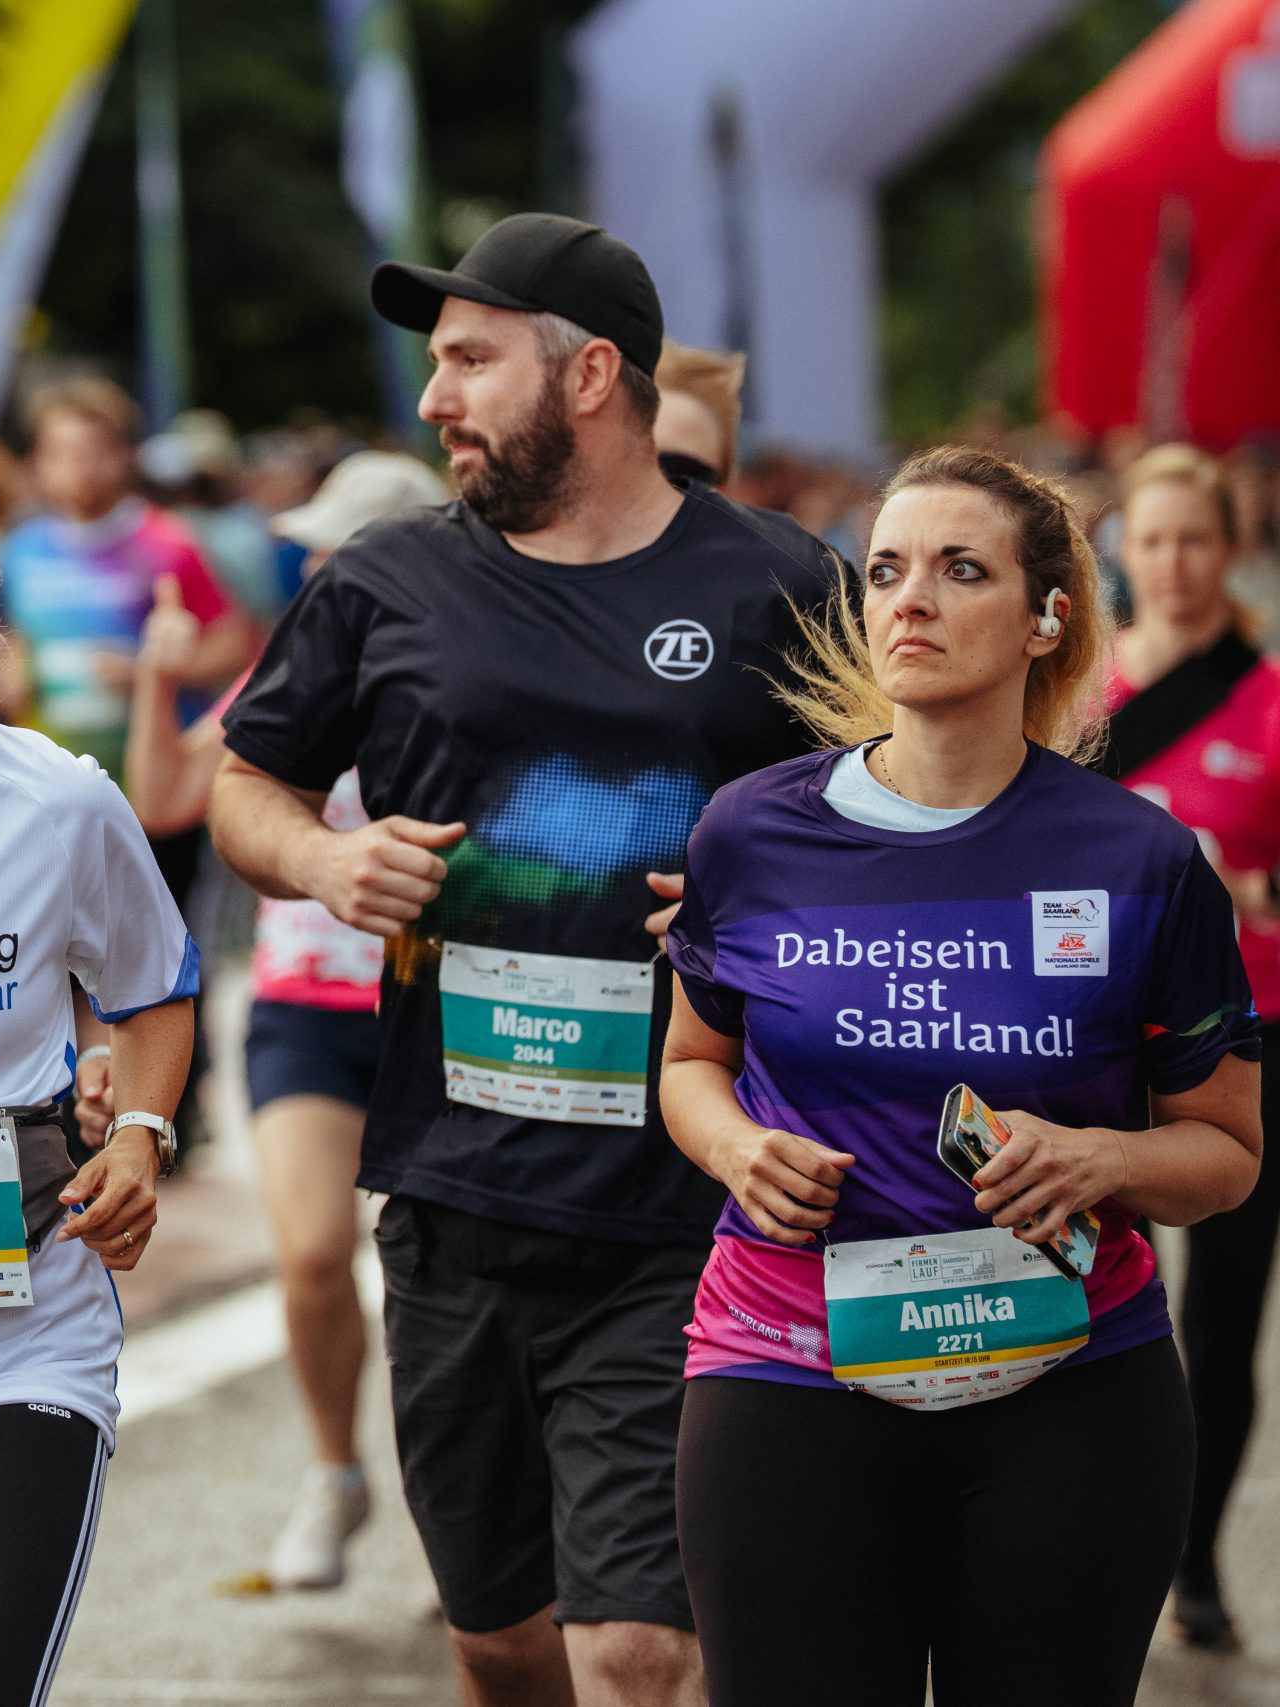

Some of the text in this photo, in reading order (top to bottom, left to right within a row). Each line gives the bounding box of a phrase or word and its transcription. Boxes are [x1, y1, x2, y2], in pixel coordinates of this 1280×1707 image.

[650, 629, 709, 670] ZF
[775, 928, 1012, 970] Dabeisein
[885, 972, 948, 1012] ist
[492, 1006, 582, 1044] Marco
[835, 1008, 1074, 1058] Saarland!
[512, 1044, 555, 1065] 2044
[911, 1258, 938, 1268] FIRMEN
[913, 1268, 939, 1279] LAUF
[727, 1305, 782, 1342] SAARLAND
[900, 1293, 1016, 1332] Annika
[936, 1332, 984, 1353] 2271
[934, 1357, 963, 1367] STARTZEIT
[27, 1402, 71, 1419] adidas
